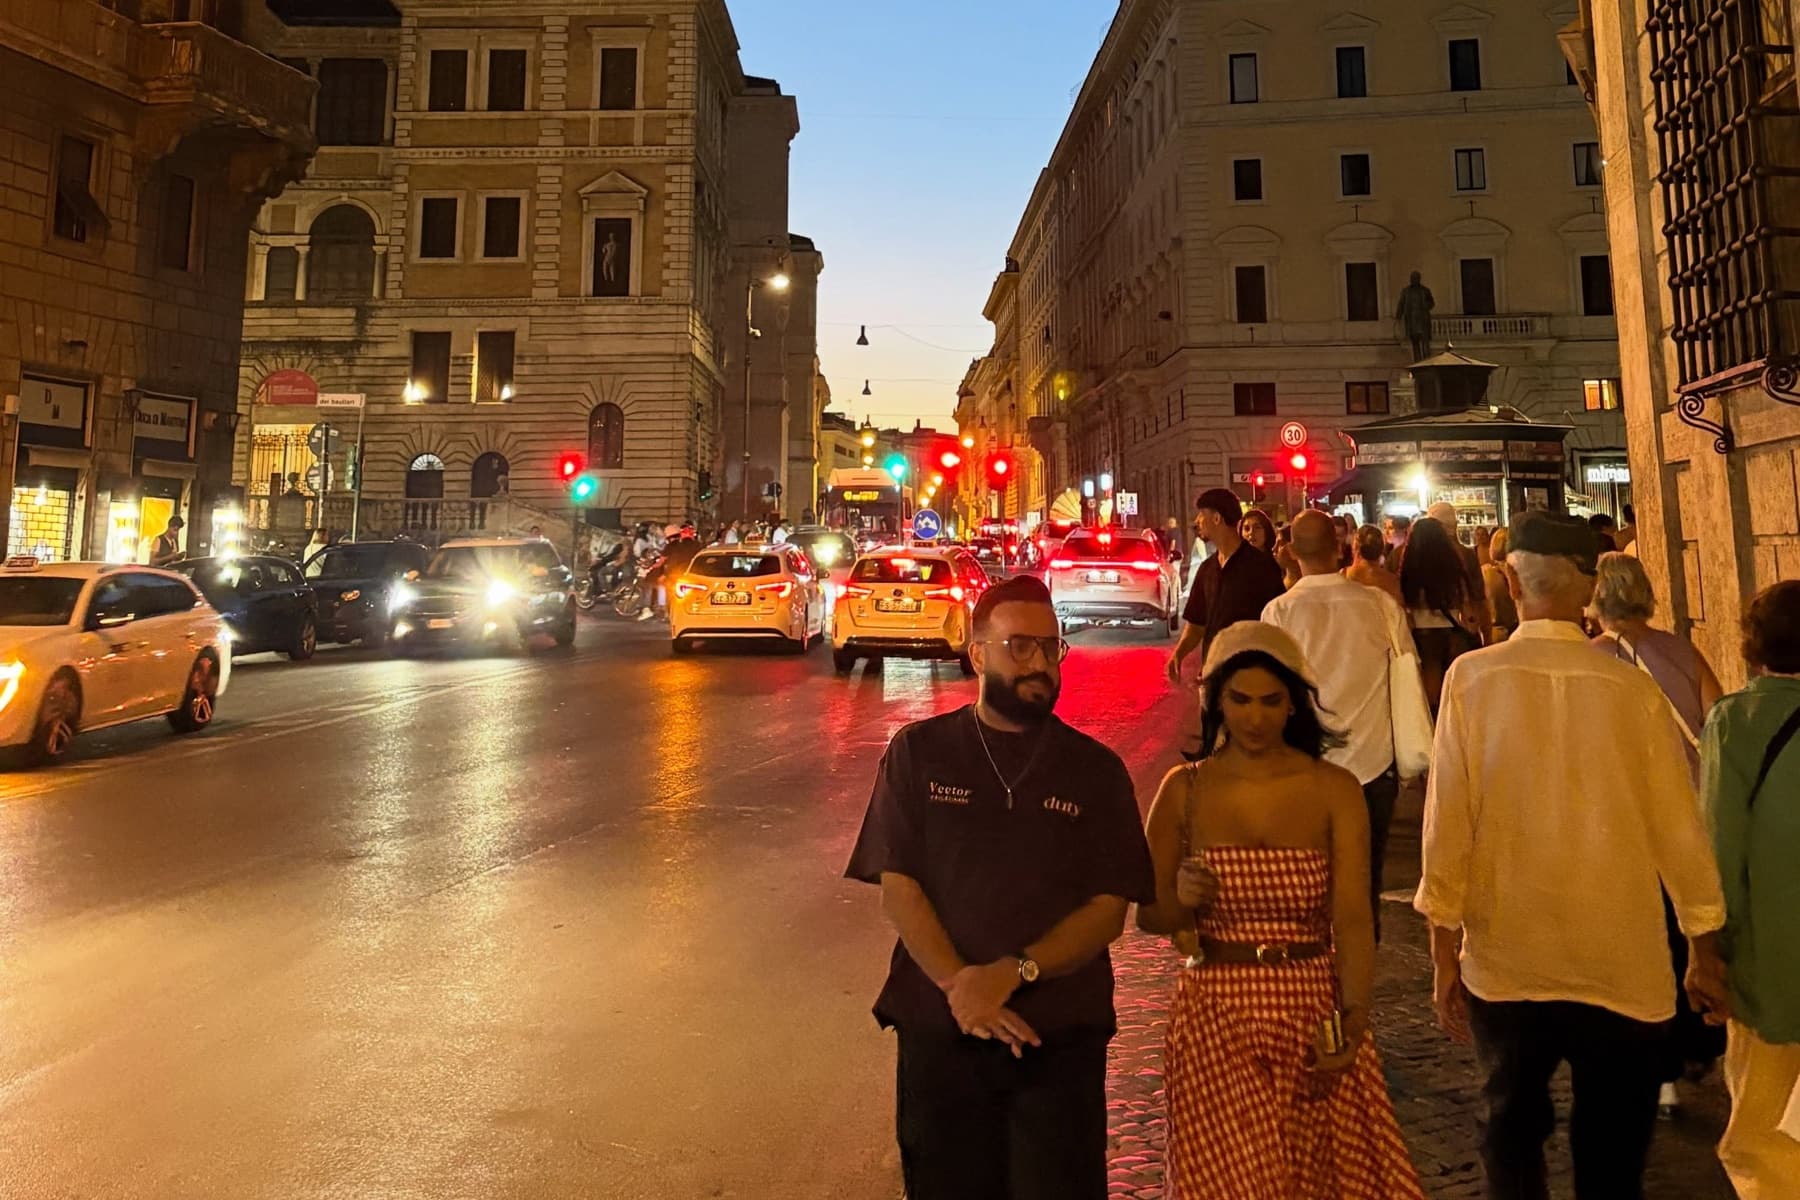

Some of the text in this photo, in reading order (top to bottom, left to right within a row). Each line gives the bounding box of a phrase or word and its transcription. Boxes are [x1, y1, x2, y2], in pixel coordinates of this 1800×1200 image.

[1287, 429, 1301, 442] 30
[930, 781, 973, 797] Vector
[1043, 795, 1081, 817] duty
